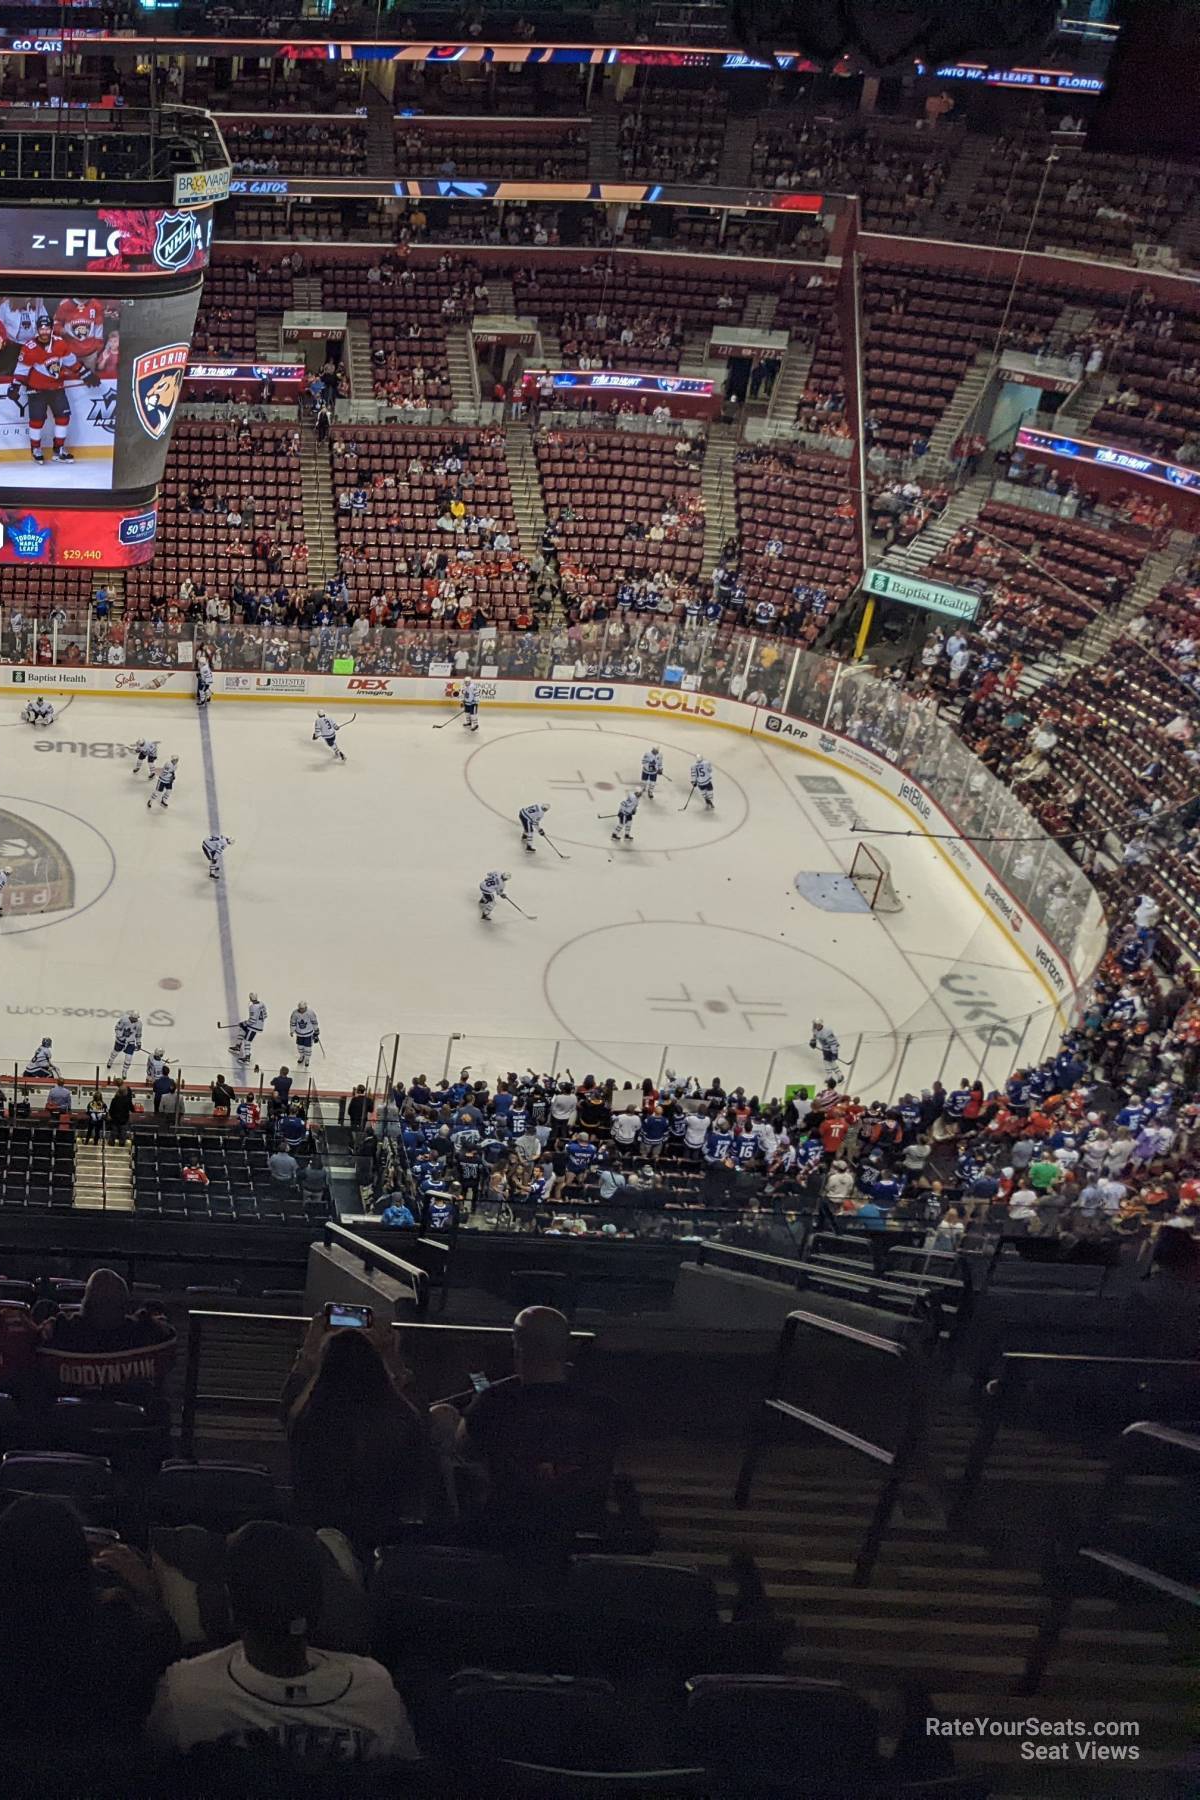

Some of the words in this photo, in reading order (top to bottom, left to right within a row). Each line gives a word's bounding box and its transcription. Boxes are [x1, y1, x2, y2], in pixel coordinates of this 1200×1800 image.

[12, 40, 32, 51] GO
[34, 40, 63, 51] CATS
[1002, 71, 1034, 83] LEAFS
[249, 181, 288, 194] GATOS
[163, 227, 192, 259] NHL
[126, 524, 138, 535] 50
[15, 533, 43, 543] TORONTO
[63, 549, 102, 560] $29,440
[891, 580, 931, 605] Baptist
[932, 591, 972, 614] Health
[28, 673, 56, 684] Baptist
[59, 673, 87, 684] Health
[114, 671, 136, 689] Stoli
[271, 678, 306, 688] SYLVESTER
[346, 679, 392, 690] DEX
[356, 688, 394, 698] imaging
[534, 685, 614, 701] GEICO
[645, 690, 717, 717] SOLIS
[898, 781, 931, 820] jetBlue
[1034, 944, 1065, 991] verizon
[513, 1120, 524, 1133] 16
[831, 1127, 840, 1138] 11
[715, 1144, 728, 1157] 14
[740, 1146, 753, 1158] 16
